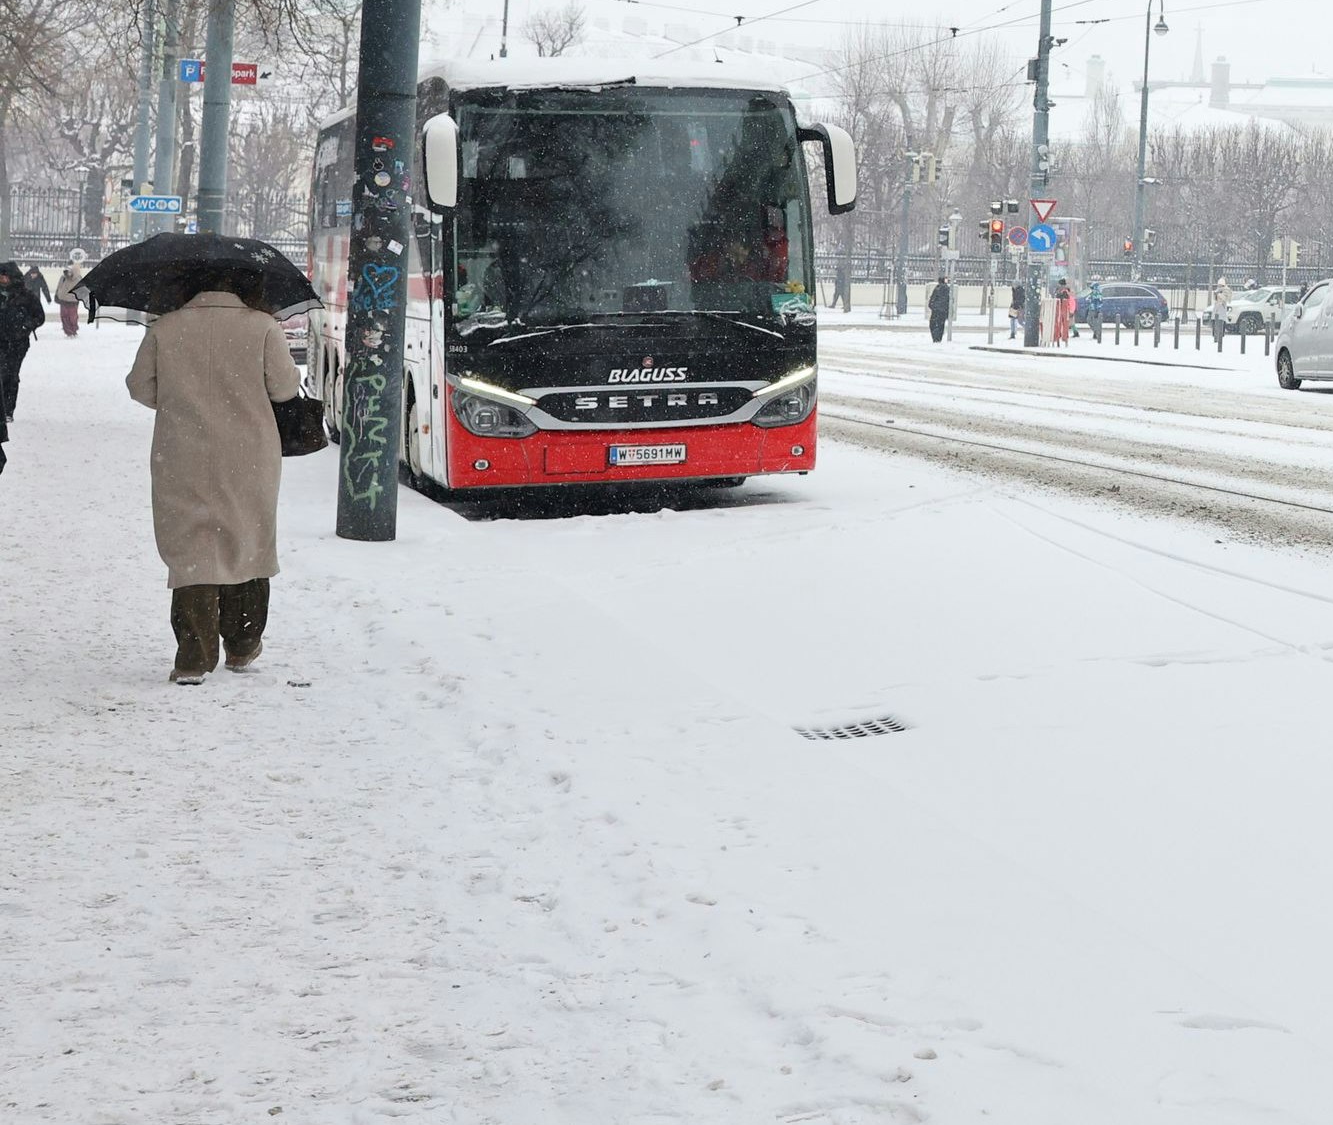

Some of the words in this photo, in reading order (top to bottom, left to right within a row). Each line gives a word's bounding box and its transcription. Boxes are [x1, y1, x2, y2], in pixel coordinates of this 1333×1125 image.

[186, 67, 195, 77] P
[137, 199, 156, 210] WC
[607, 367, 688, 383] BLAGUSS
[575, 392, 718, 409] SETRA
[619, 449, 627, 460] W
